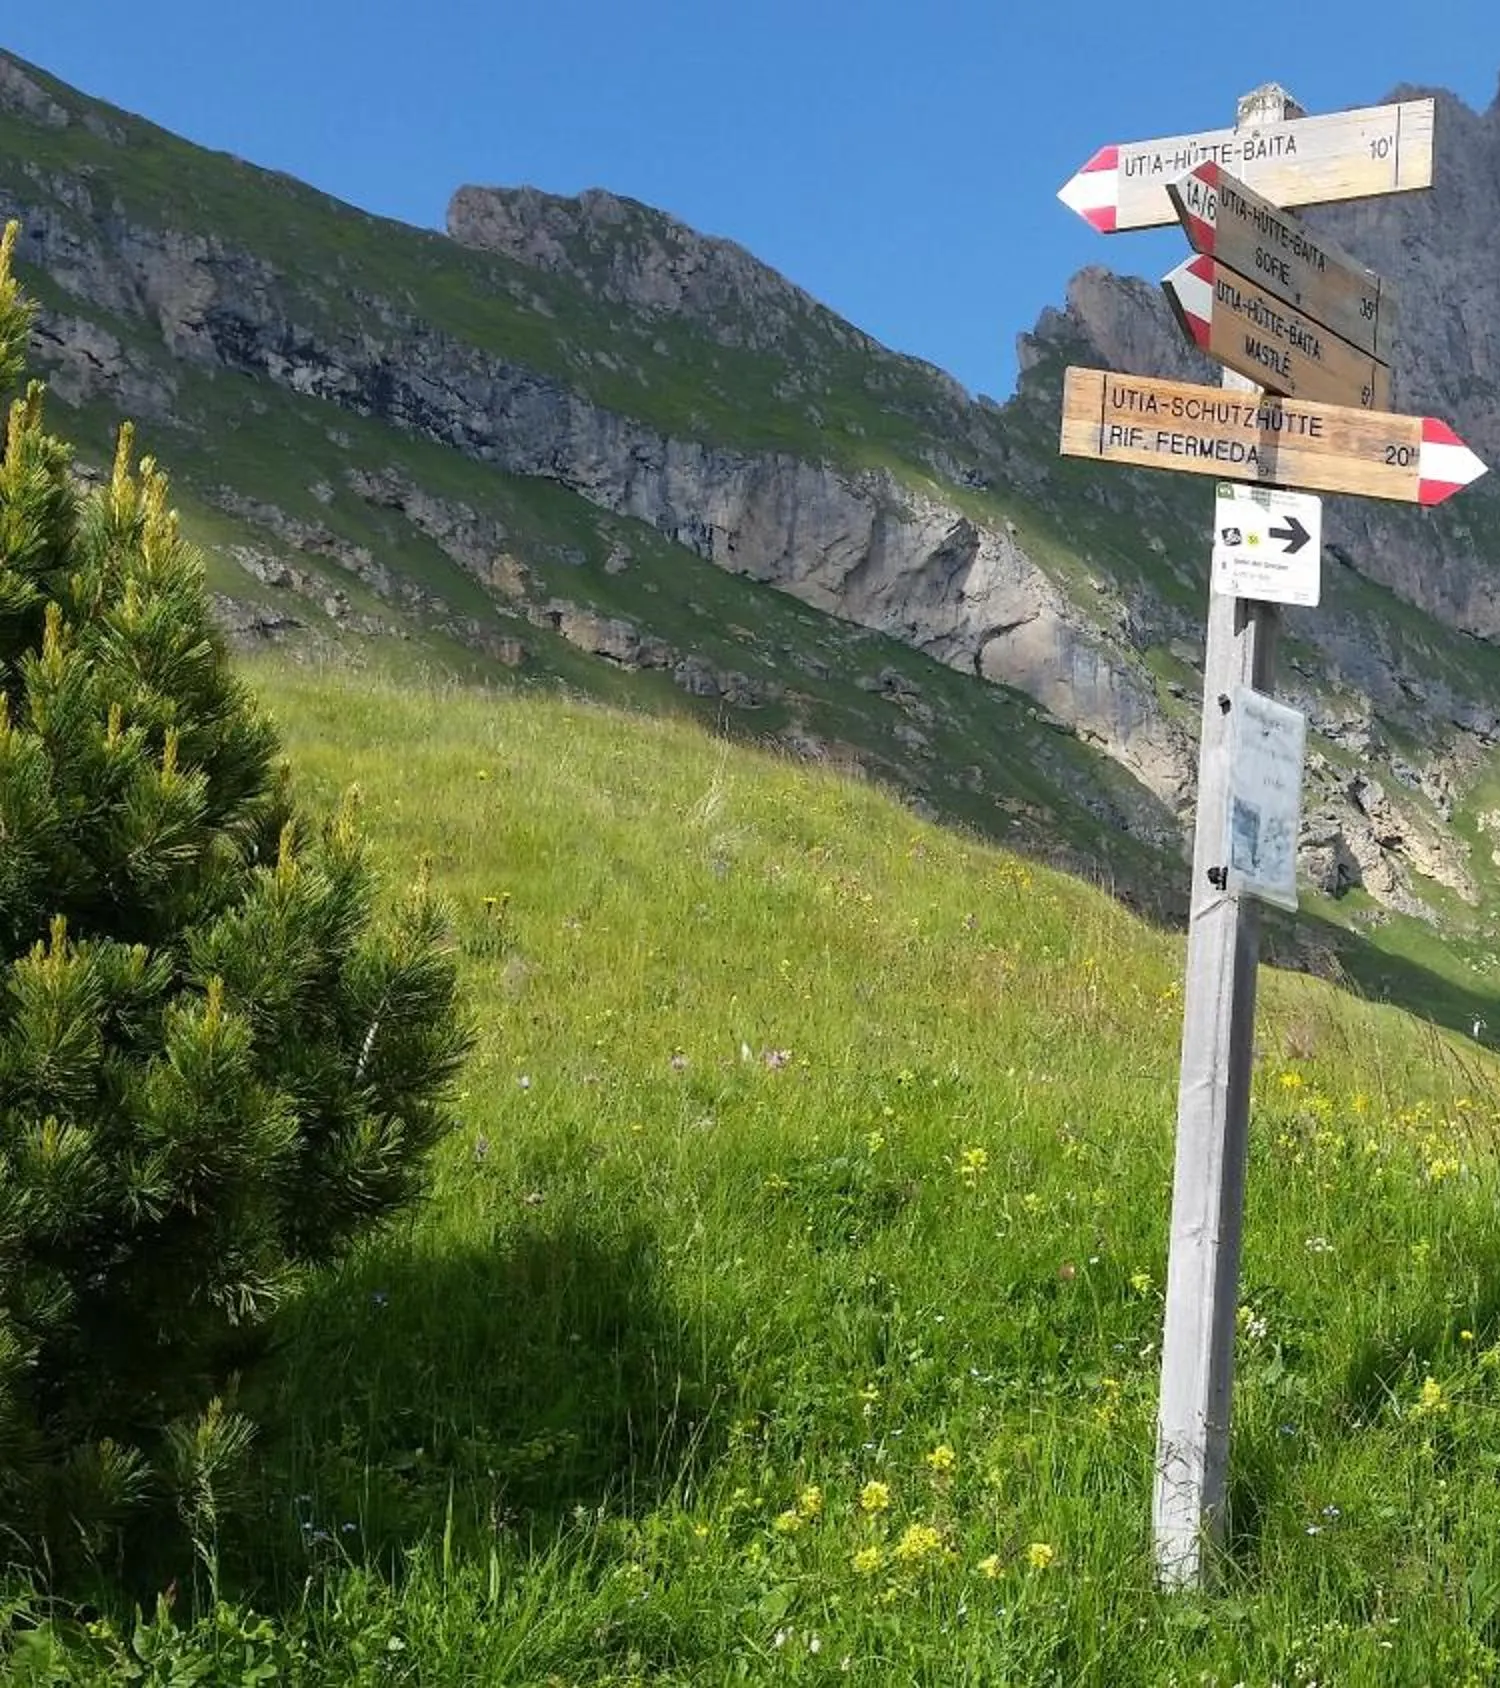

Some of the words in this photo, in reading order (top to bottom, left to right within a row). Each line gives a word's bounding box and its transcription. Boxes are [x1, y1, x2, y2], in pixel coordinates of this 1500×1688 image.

[1255, 247, 1291, 286] SOFIE
[1109, 425, 1149, 451] RIF.
[1156, 431, 1260, 464] FERMEDA
